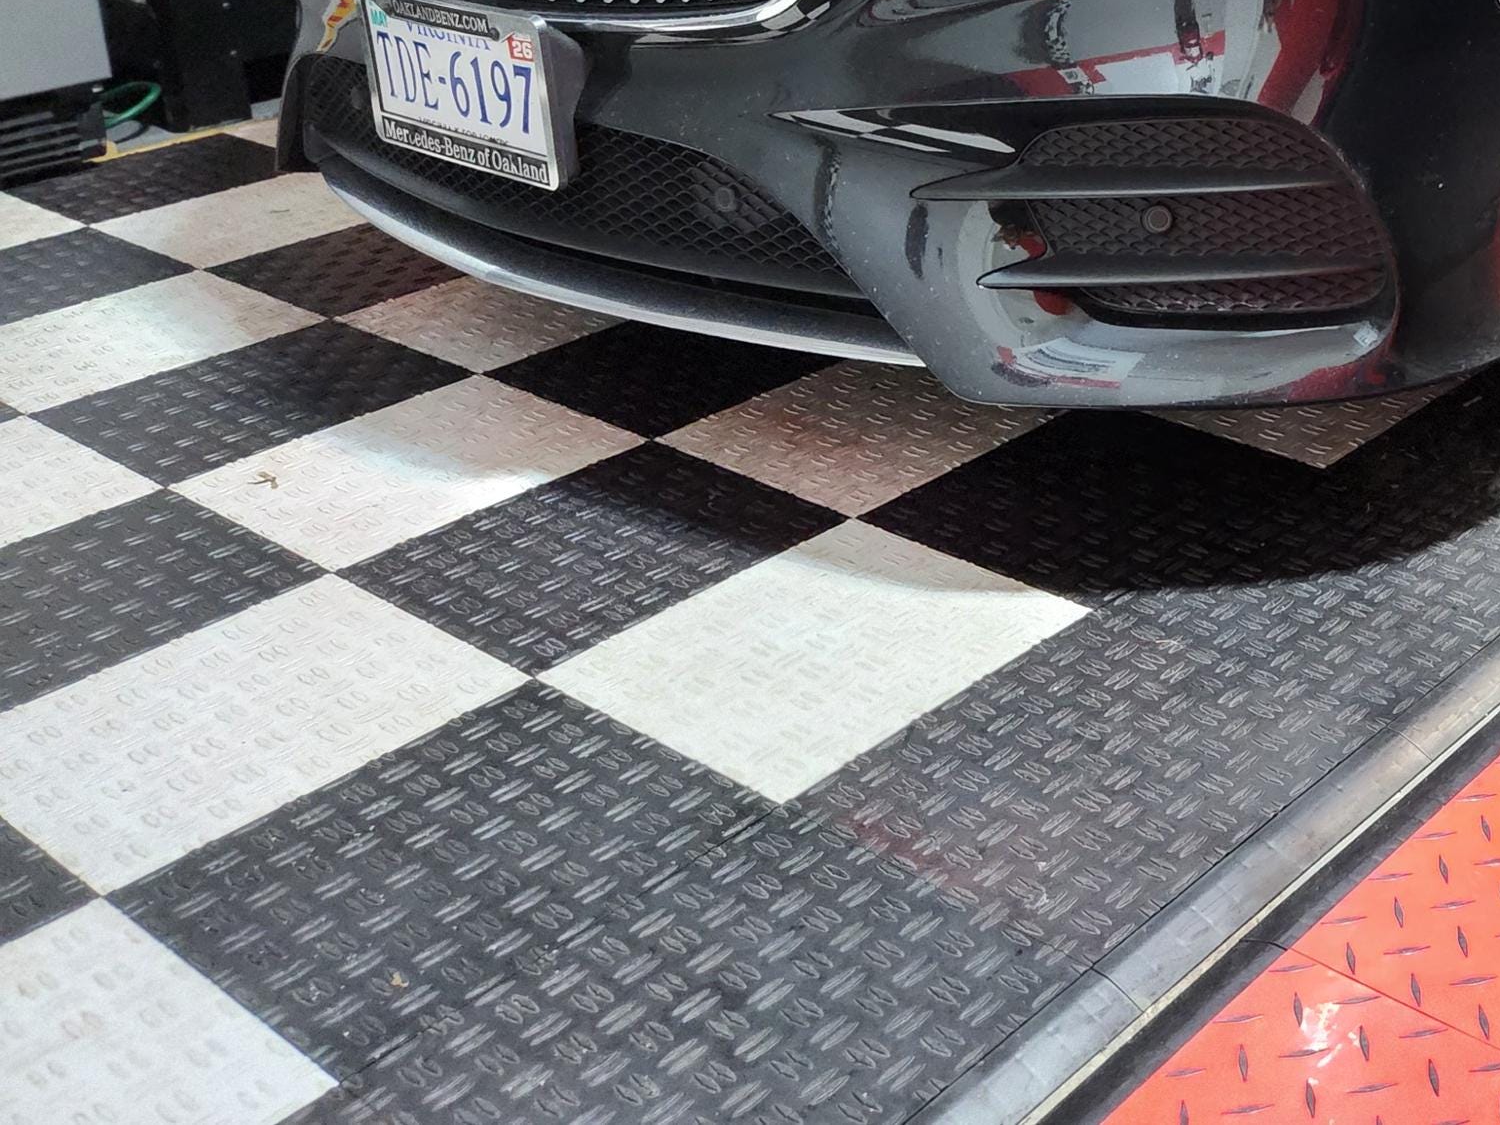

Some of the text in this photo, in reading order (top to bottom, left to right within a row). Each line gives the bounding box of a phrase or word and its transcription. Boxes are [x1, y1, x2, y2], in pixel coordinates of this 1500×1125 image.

[376, 31, 533, 134] TDE-6197
[511, 40, 534, 60] 26
[383, 118, 476, 166] Mercedes-Benz
[477, 147, 492, 168] of
[491, 150, 549, 184] Oakland
